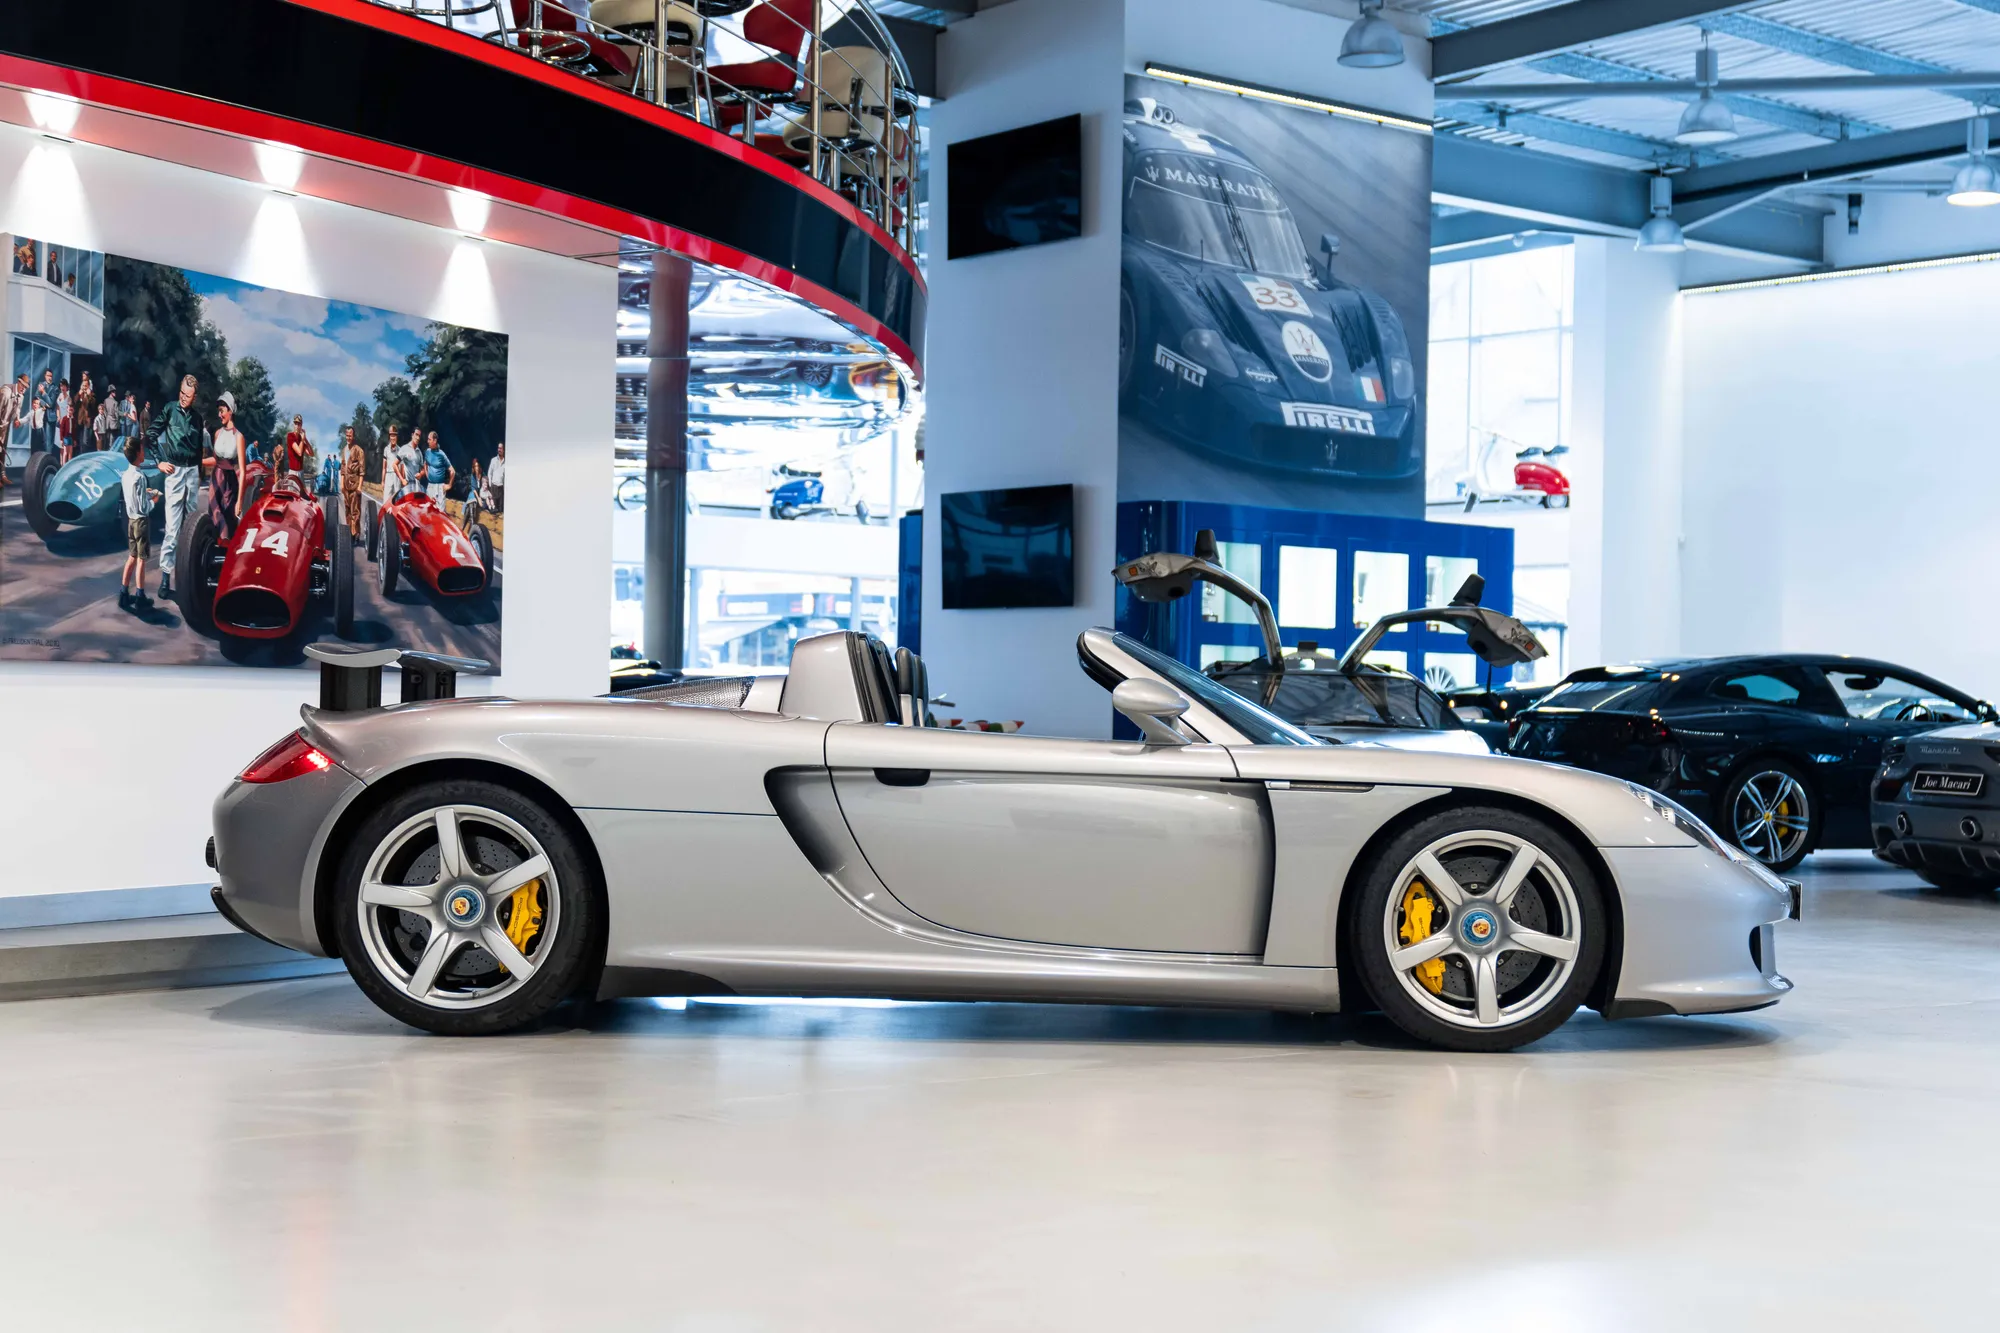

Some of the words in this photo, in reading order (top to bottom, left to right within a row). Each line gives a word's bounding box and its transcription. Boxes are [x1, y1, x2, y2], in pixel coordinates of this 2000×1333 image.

[1164, 167, 1268, 201] MASERATI
[1255, 286, 1299, 309] 33
[1154, 343, 1208, 388] PIRLLI
[1280, 401, 1376, 436] PIRELLI
[74, 475, 104, 501] 18
[235, 527, 290, 559] 14
[442, 534, 466, 559] 2
[1922, 775, 1938, 789] Joe
[1939, 775, 1972, 791] Macari
[511, 897, 524, 939] PORSCHE
